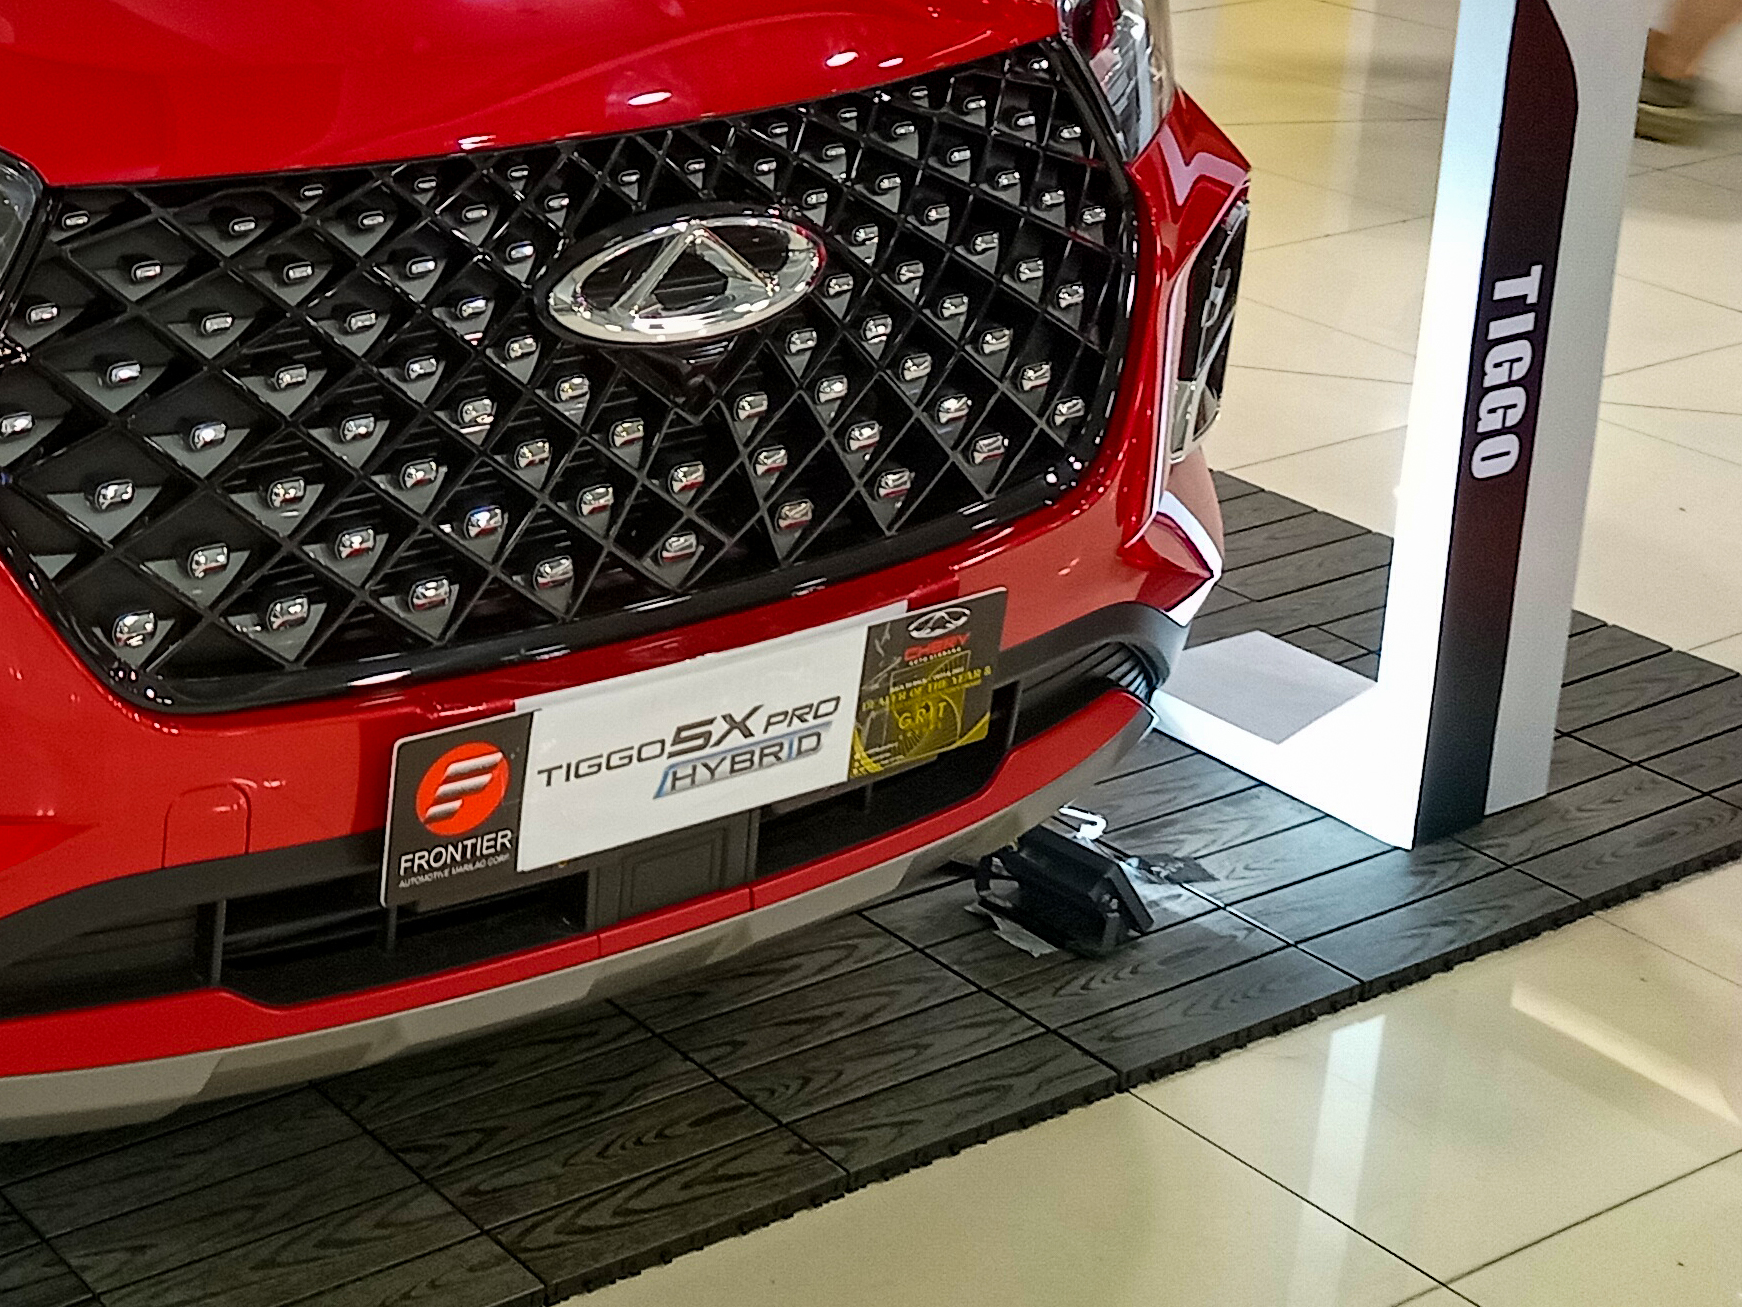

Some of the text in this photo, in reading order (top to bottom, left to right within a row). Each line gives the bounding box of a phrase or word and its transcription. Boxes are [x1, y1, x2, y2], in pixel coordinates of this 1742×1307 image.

[1470, 263, 1543, 480] TIGGO
[762, 695, 841, 735] PRO
[670, 730, 822, 792] HYBRID
[399, 829, 513, 877] FRONTIER
